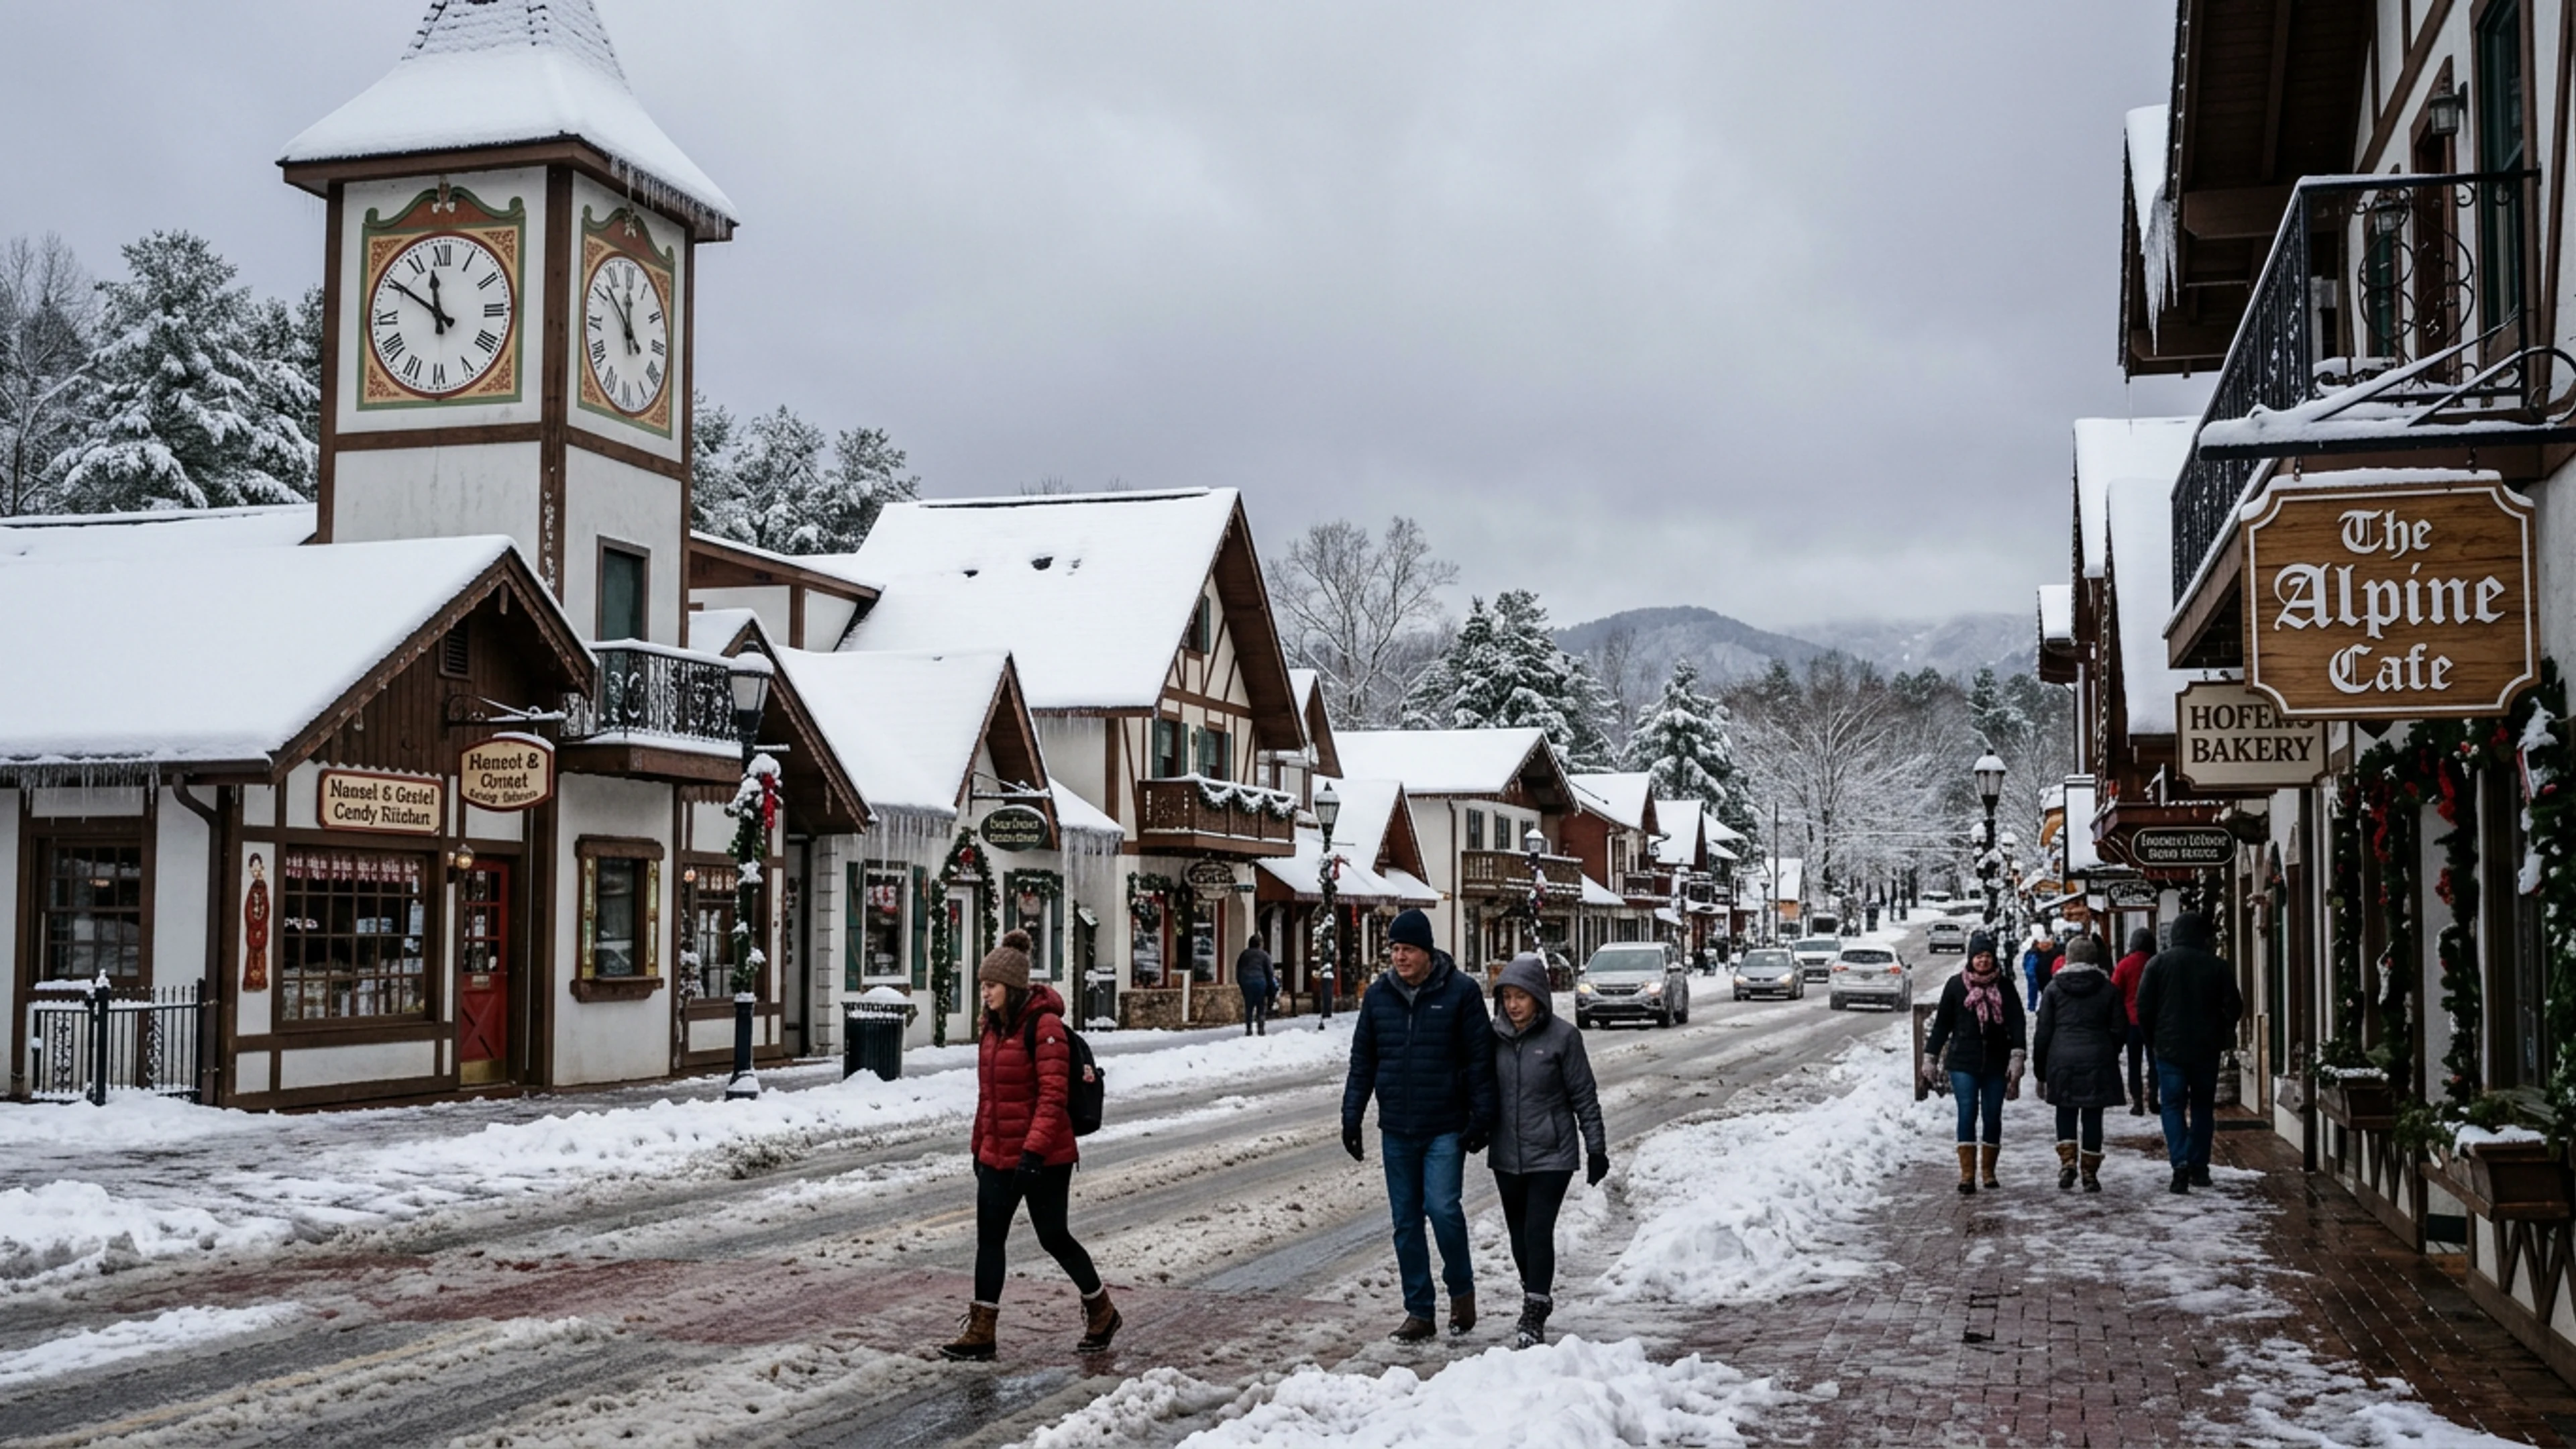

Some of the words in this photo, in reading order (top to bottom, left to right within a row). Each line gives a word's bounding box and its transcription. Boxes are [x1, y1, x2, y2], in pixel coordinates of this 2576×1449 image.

[2337, 509, 2433, 559] The
[2273, 561, 2506, 639] Alpine
[2328, 643, 2454, 694] Cafe
[526, 752, 539, 769] &
[2192, 736, 2314, 763] BAKERY
